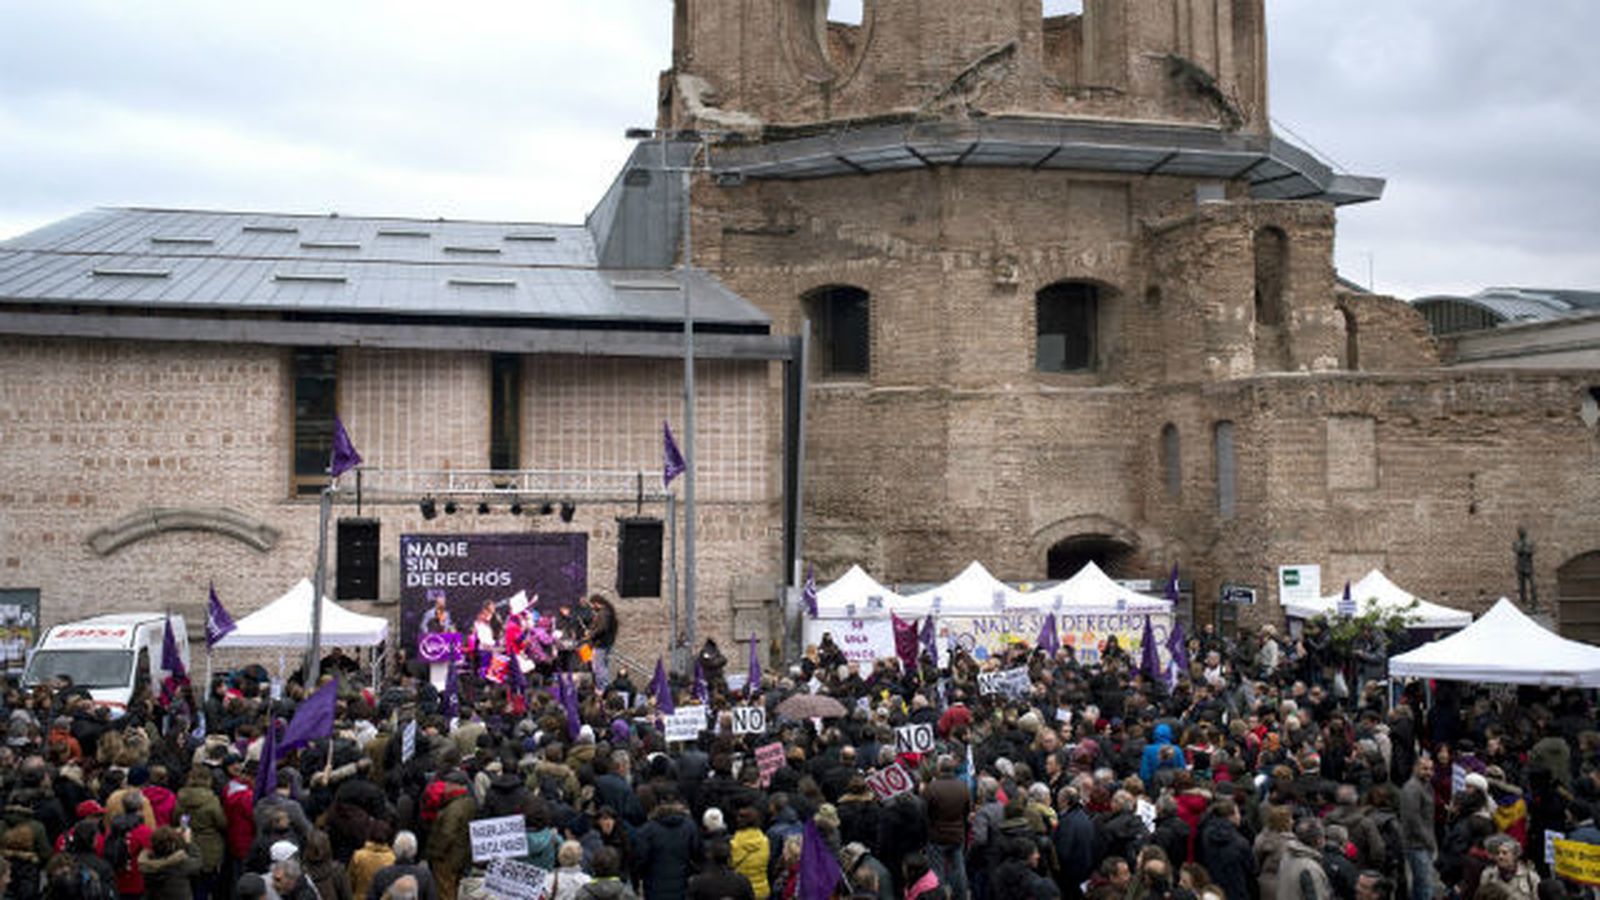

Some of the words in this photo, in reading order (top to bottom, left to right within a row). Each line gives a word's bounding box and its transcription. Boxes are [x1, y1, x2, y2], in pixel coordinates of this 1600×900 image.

[406, 541, 469, 556] NADIE
[405, 557, 439, 571] SIN
[406, 571, 512, 587] DERECHOS
[973, 616, 1026, 635] NADIE
[1061, 614, 1143, 632] DERECHO
[733, 708, 765, 731] NO
[896, 726, 931, 751] NO
[865, 766, 907, 797] NO
